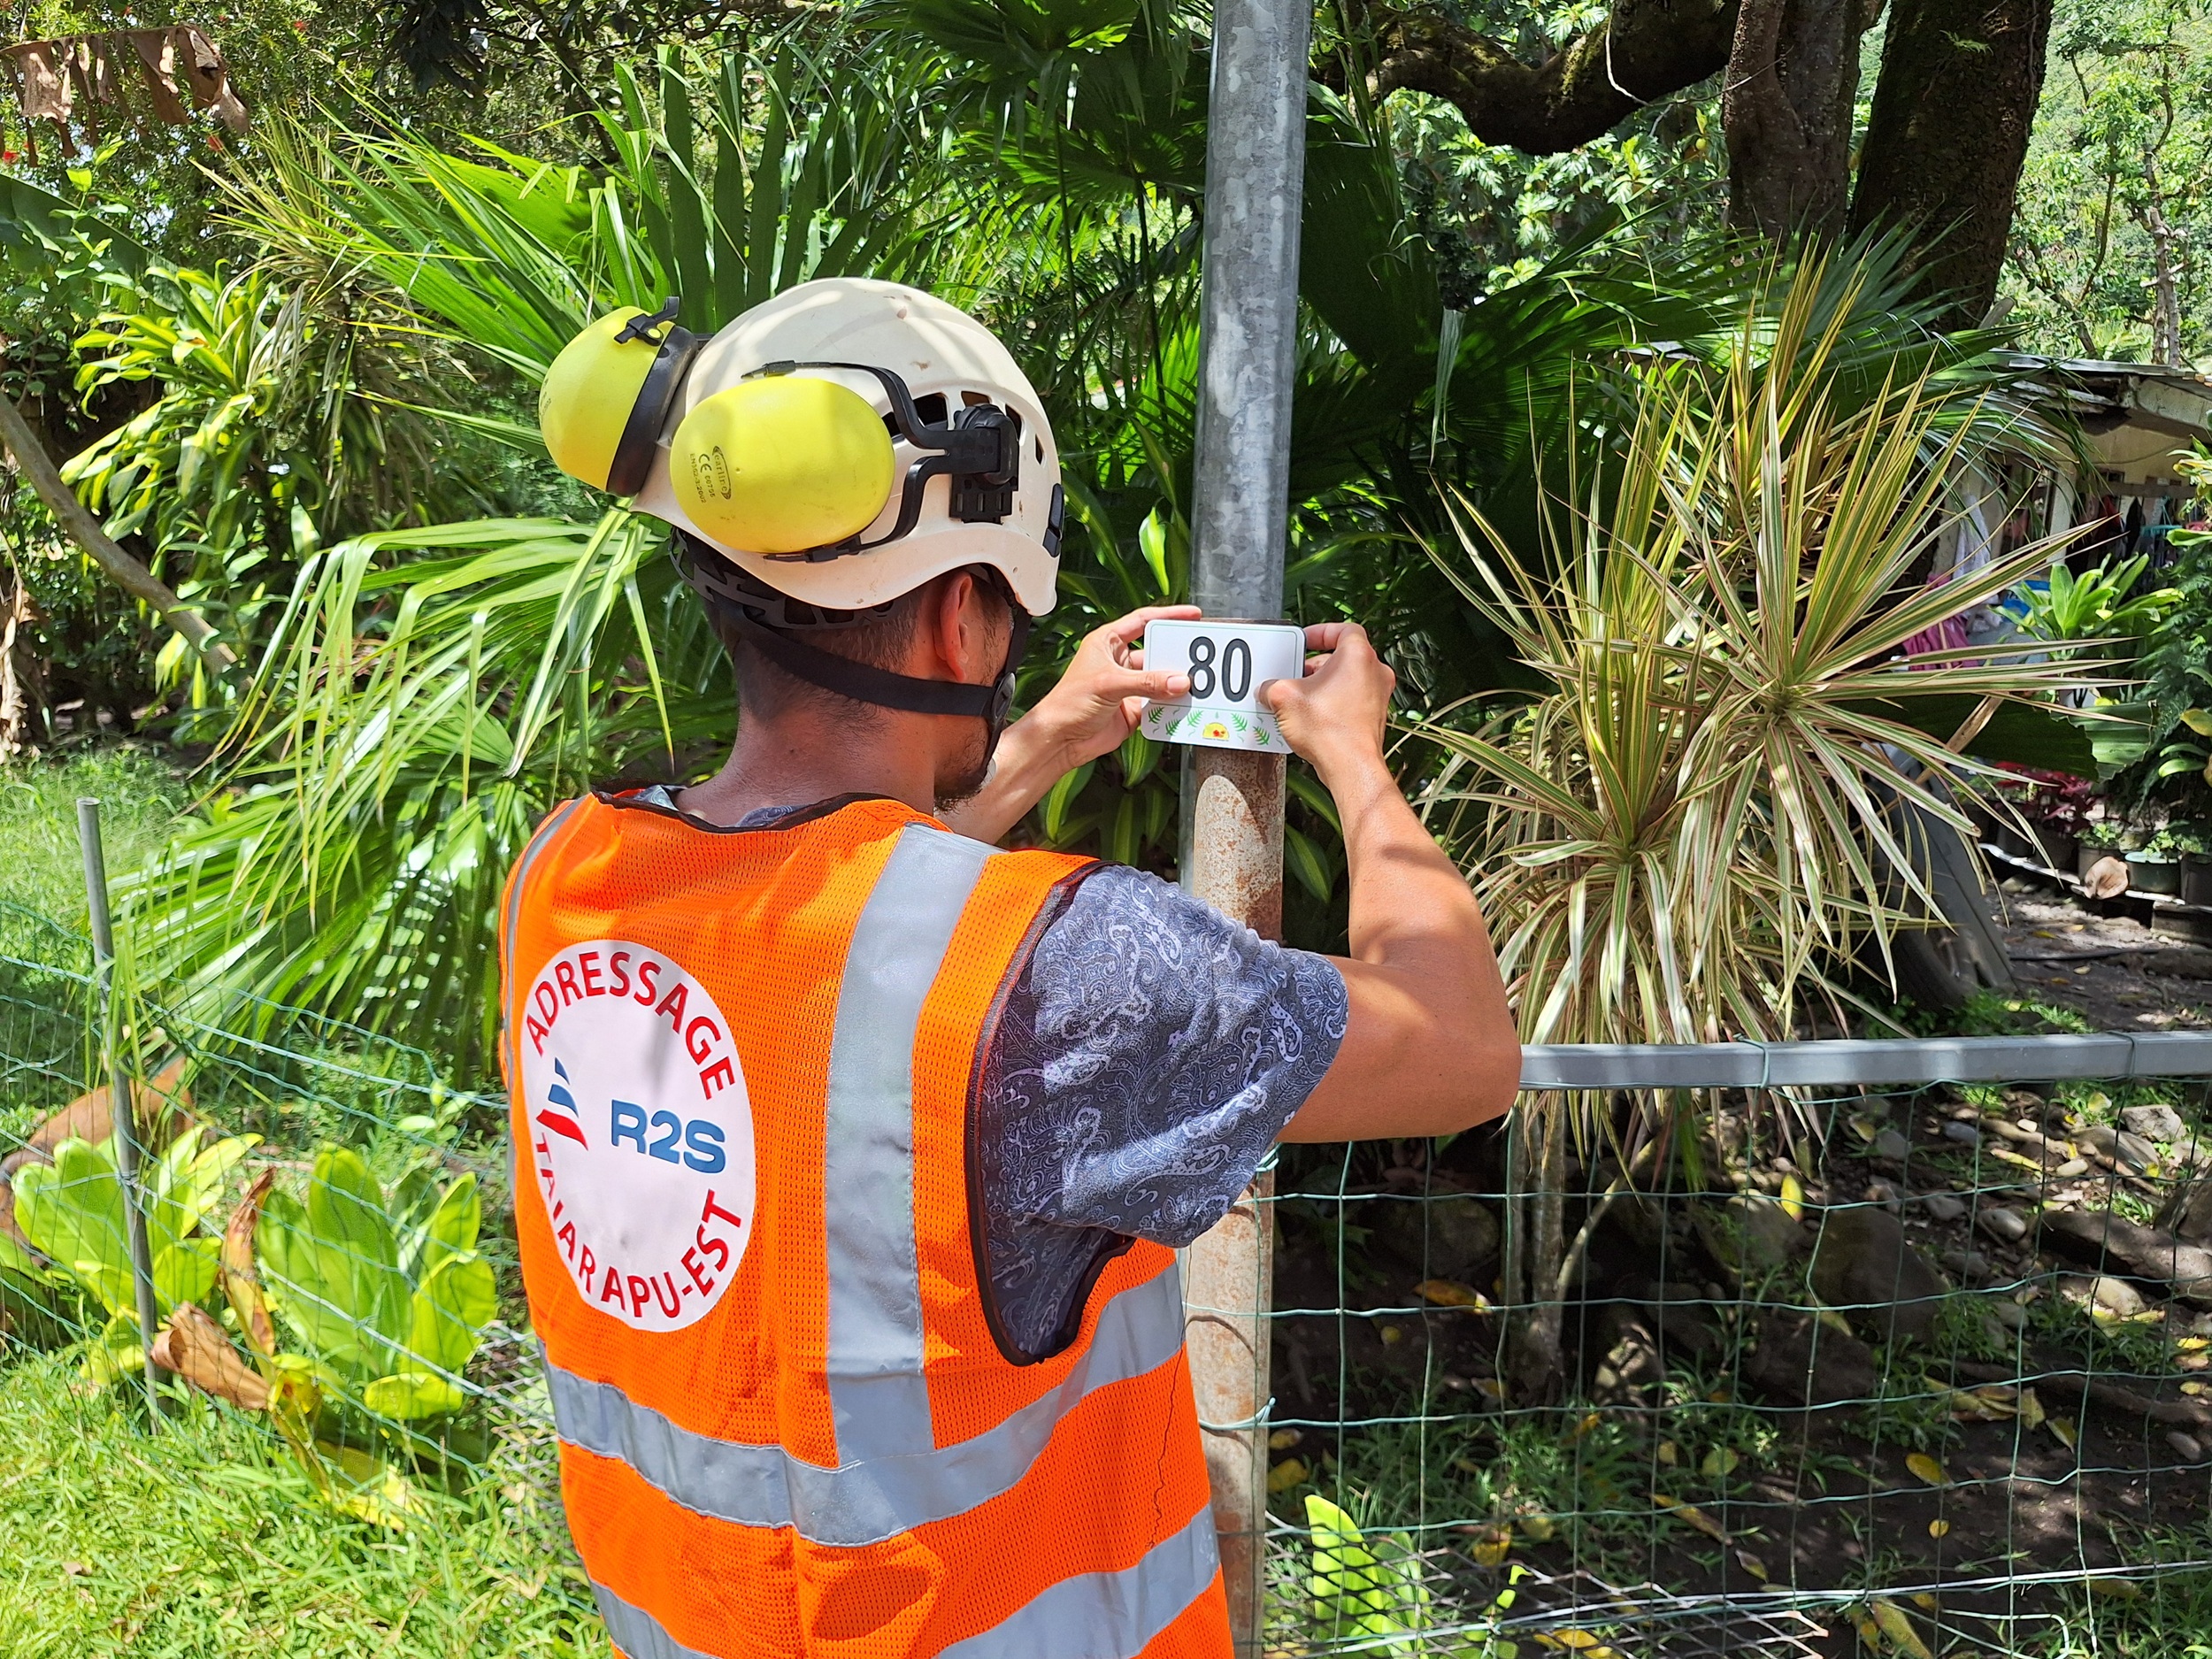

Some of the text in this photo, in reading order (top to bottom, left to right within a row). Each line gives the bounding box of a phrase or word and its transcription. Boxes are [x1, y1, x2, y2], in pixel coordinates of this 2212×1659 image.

[1187, 636, 1251, 703] 80
[526, 952, 734, 1099] ADRESSAGE
[611, 1100, 726, 1173] R2S
[536, 1133, 741, 1318] TAIARAPU-EST
